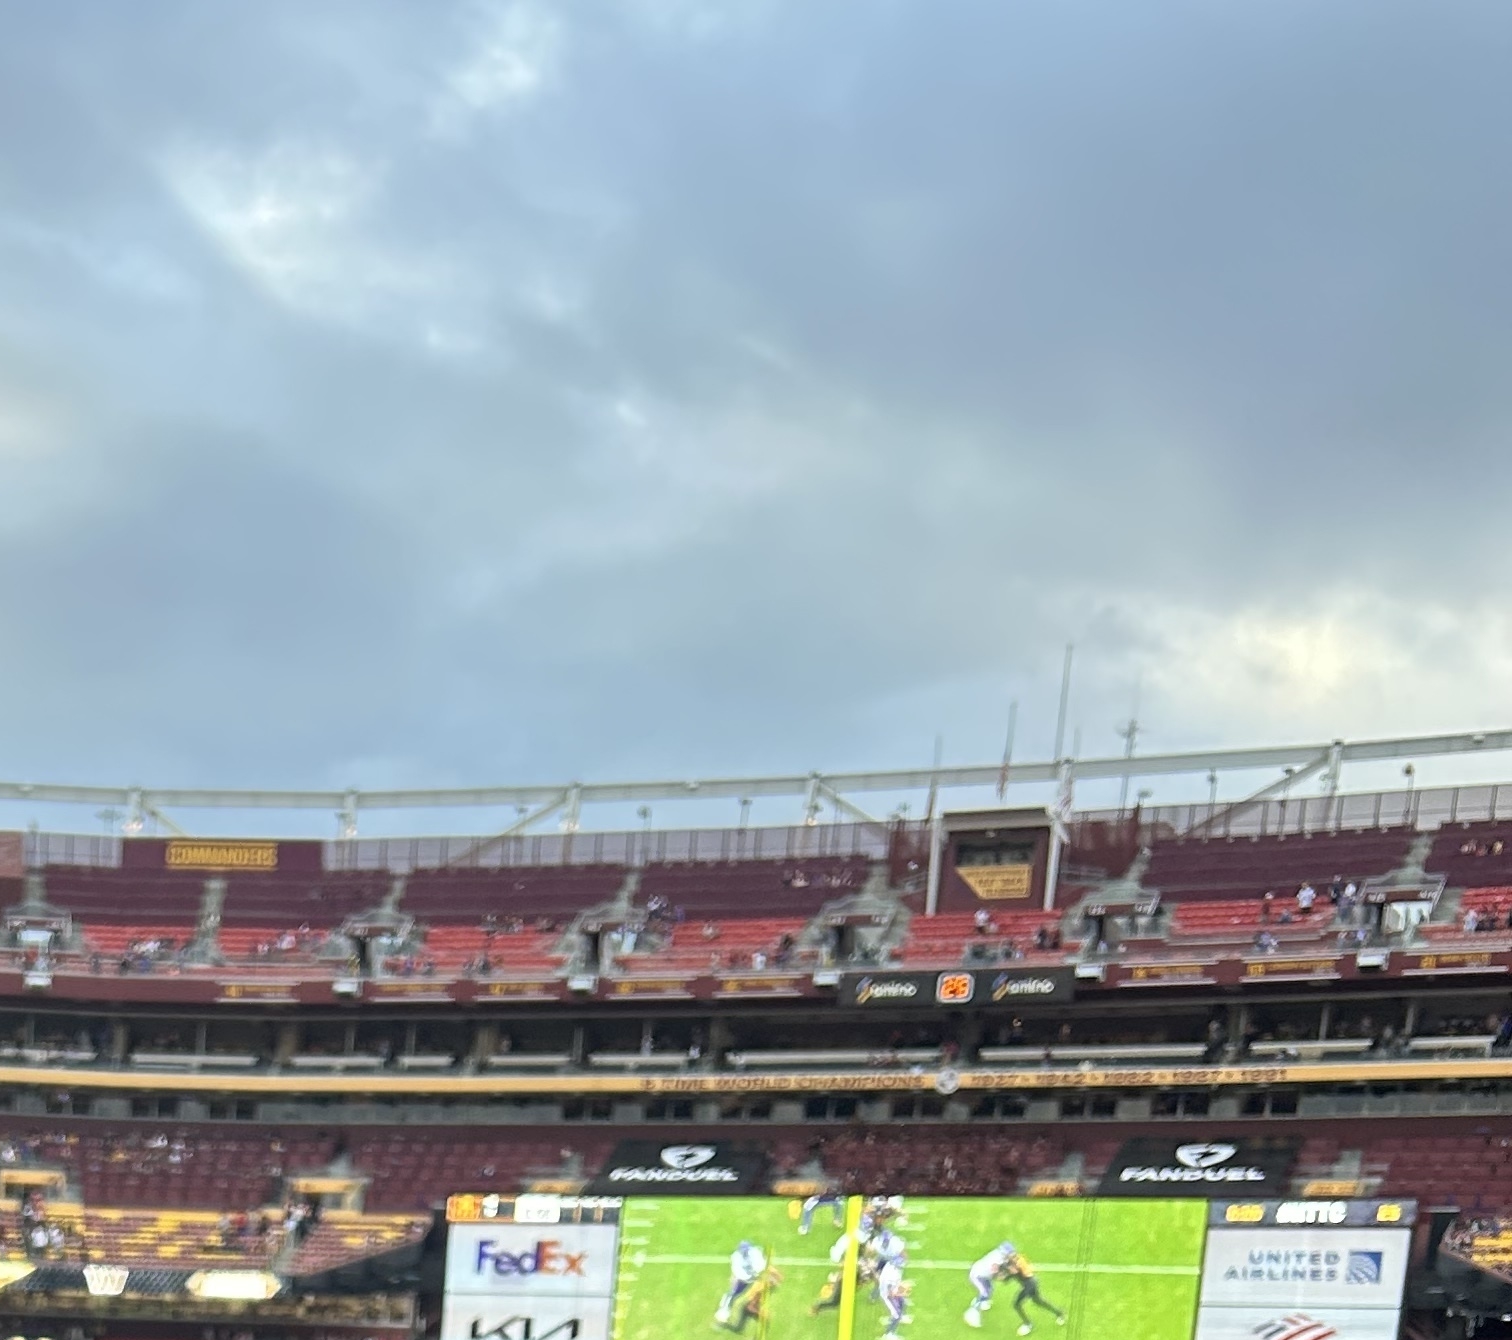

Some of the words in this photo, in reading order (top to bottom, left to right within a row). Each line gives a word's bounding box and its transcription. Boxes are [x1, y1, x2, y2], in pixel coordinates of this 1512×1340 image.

[169, 846, 278, 865] COMMANDERS
[661, 1077, 706, 1090] TIME
[715, 1076, 789, 1090] WORLD
[797, 1075, 924, 1089] CHAMPIONS
[608, 1166, 738, 1182] FANDUEL
[1119, 1166, 1266, 1182] FANDUEL
[477, 1240, 587, 1276] FedEx
[1248, 1250, 1340, 1265] UNITED
[1224, 1267, 1338, 1281] AIRLINES
